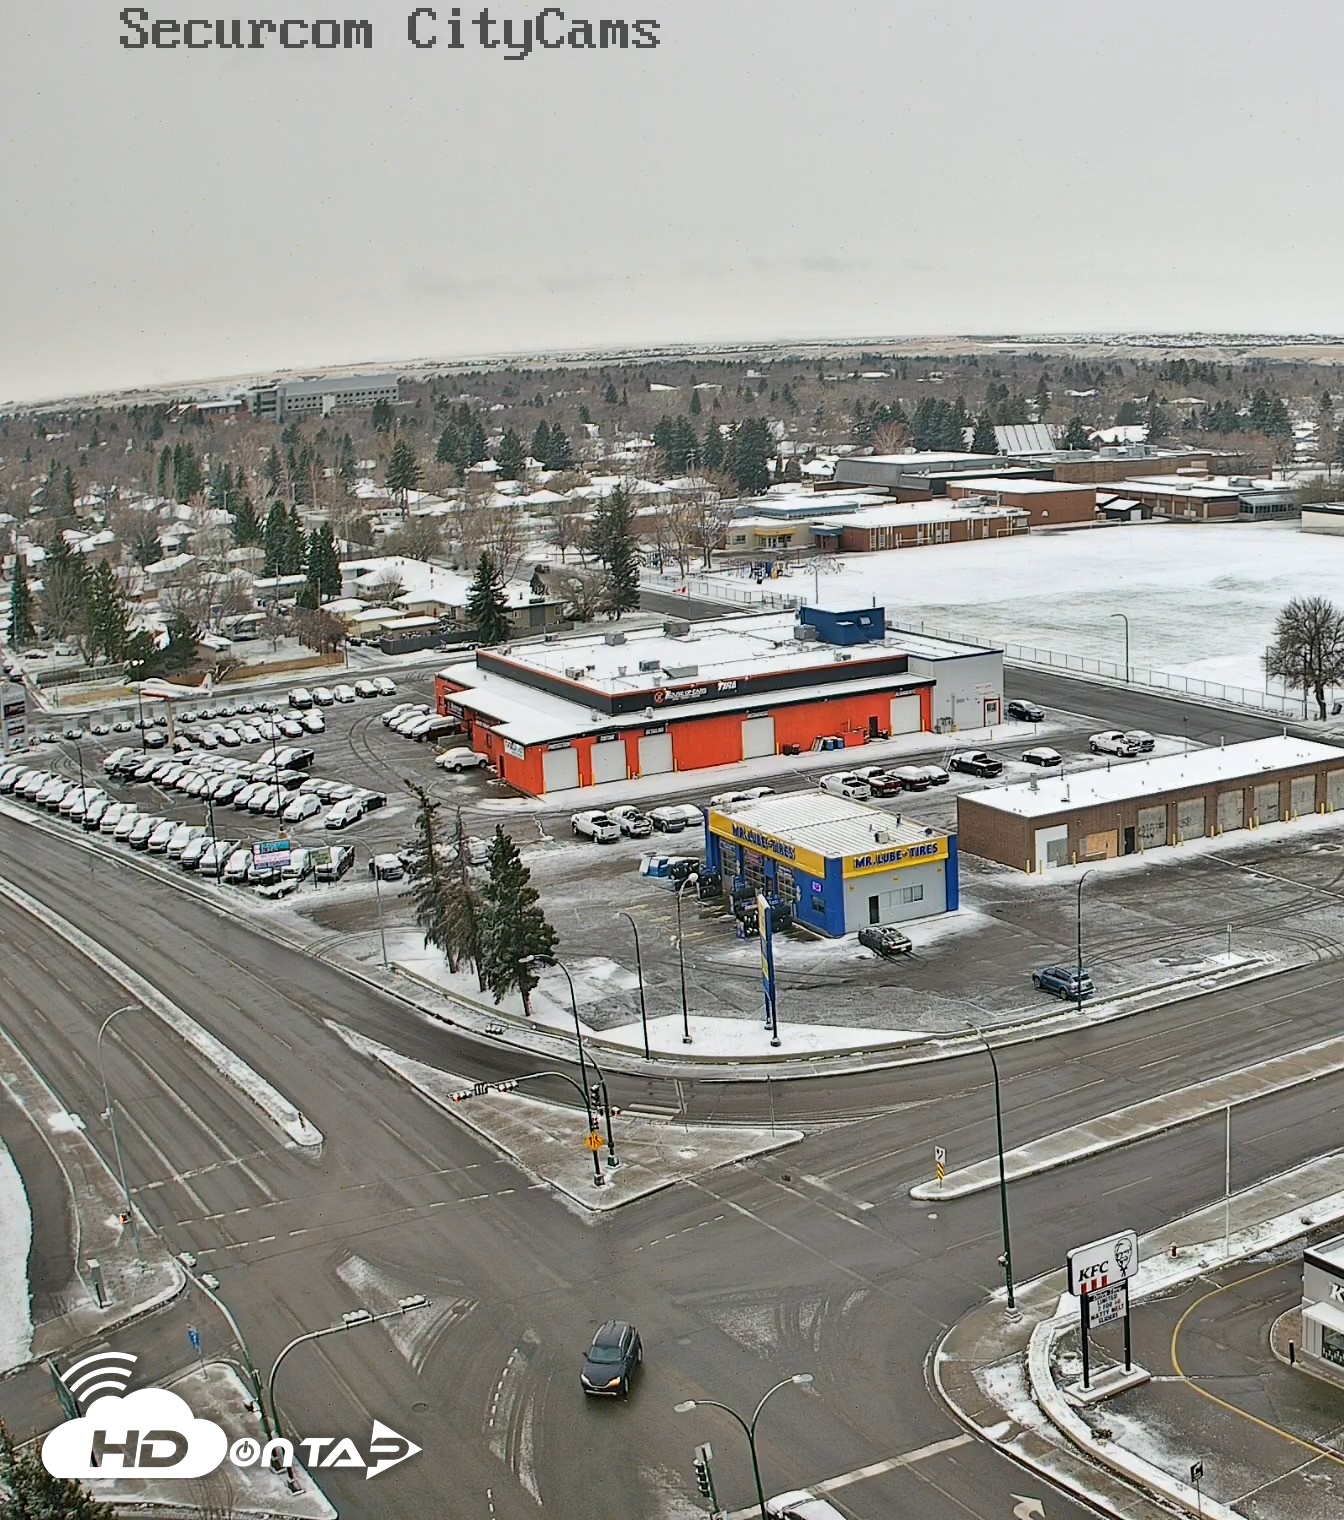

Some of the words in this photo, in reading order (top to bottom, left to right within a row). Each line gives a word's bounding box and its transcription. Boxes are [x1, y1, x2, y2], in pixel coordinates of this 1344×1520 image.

[748, 828, 768, 850] LUBE
[855, 855, 876, 869] MR.
[876, 849, 902, 864] LUBE
[909, 842, 938, 857] TIRES
[1078, 1261, 1109, 1282] KFC
